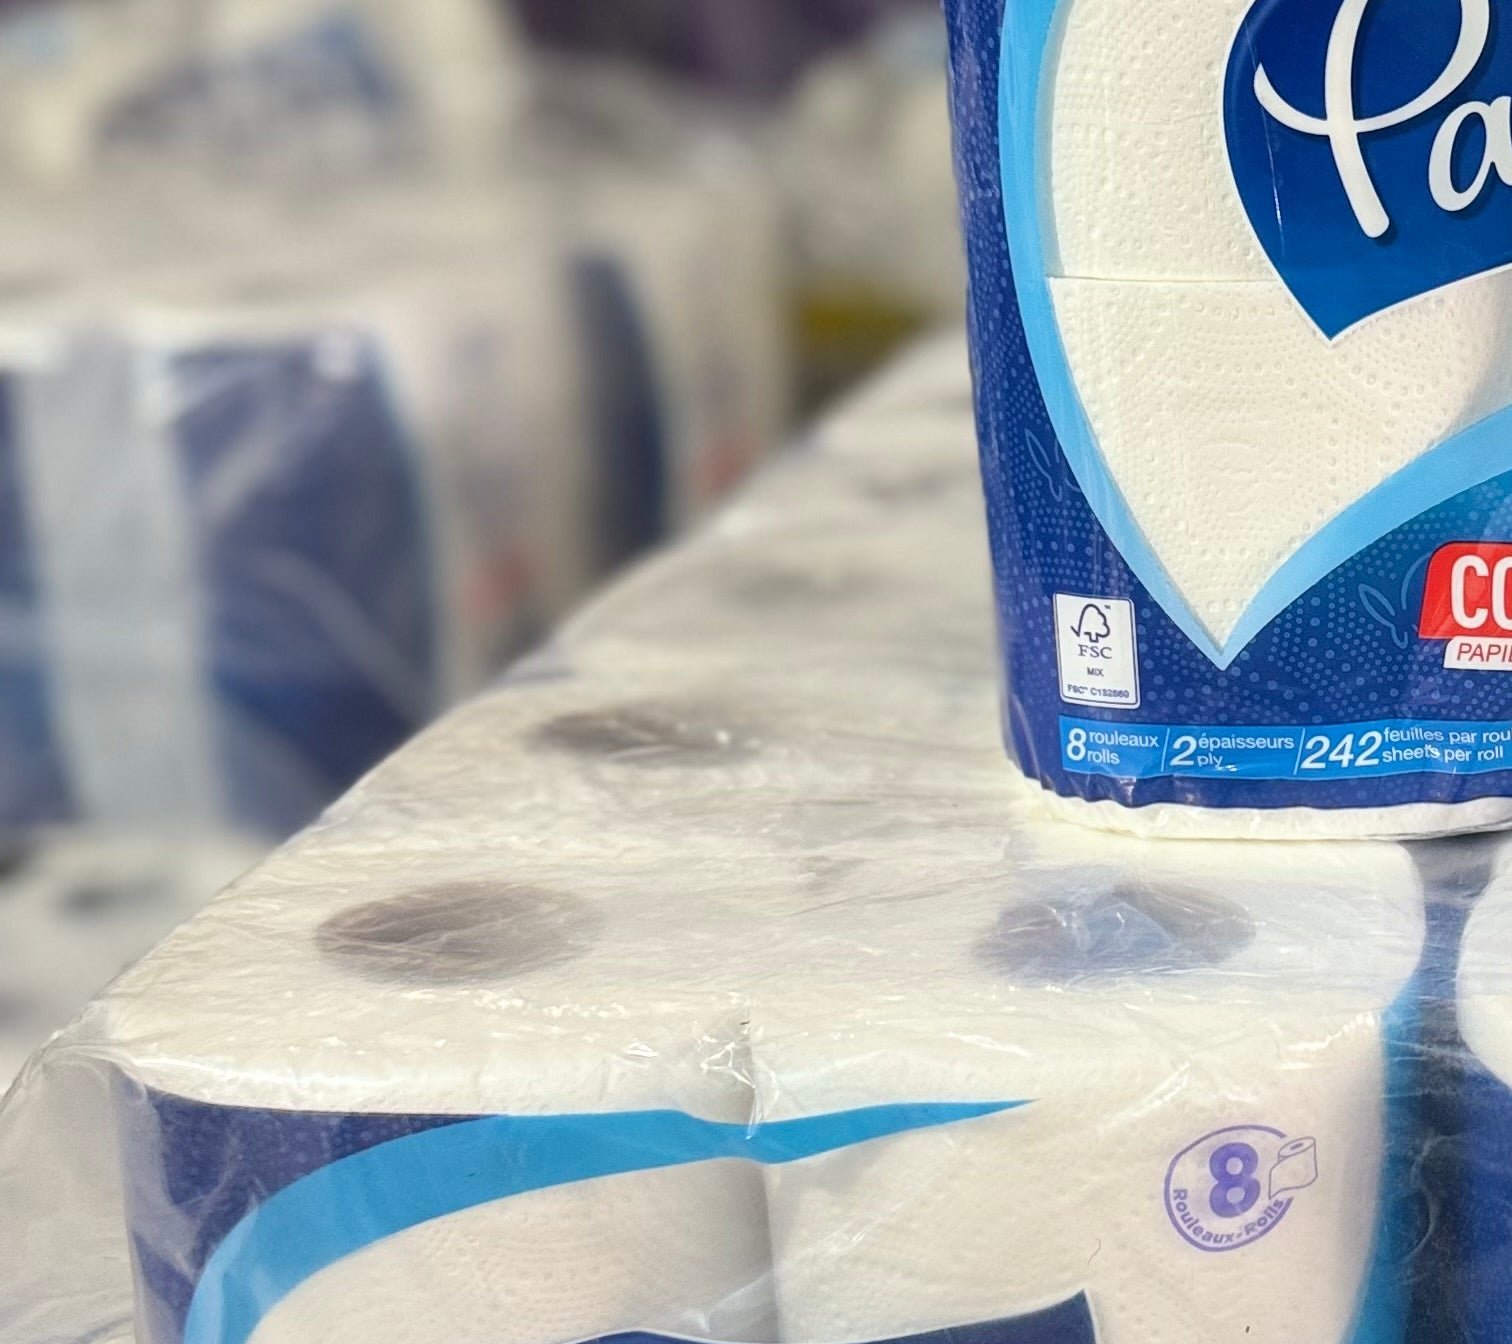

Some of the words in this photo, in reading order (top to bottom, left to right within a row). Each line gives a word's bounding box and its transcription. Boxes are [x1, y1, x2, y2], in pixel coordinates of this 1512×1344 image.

[1078, 644, 1113, 659] FSC
[1066, 728, 1087, 762] 8
[1087, 729, 1160, 749] rouleaux
[1086, 748, 1120, 765] rolls
[1170, 735, 1197, 766] 2
[1198, 732, 1295, 751] épaisseurs
[1300, 730, 1383, 770] 242
[1383, 726, 1444, 743] feuilles
[1449, 732, 1477, 747] par
[1444, 748, 1473, 764] per
[1476, 745, 1504, 761] roll
[1196, 753, 1223, 768] ply
[1209, 1142, 1261, 1219] 8
